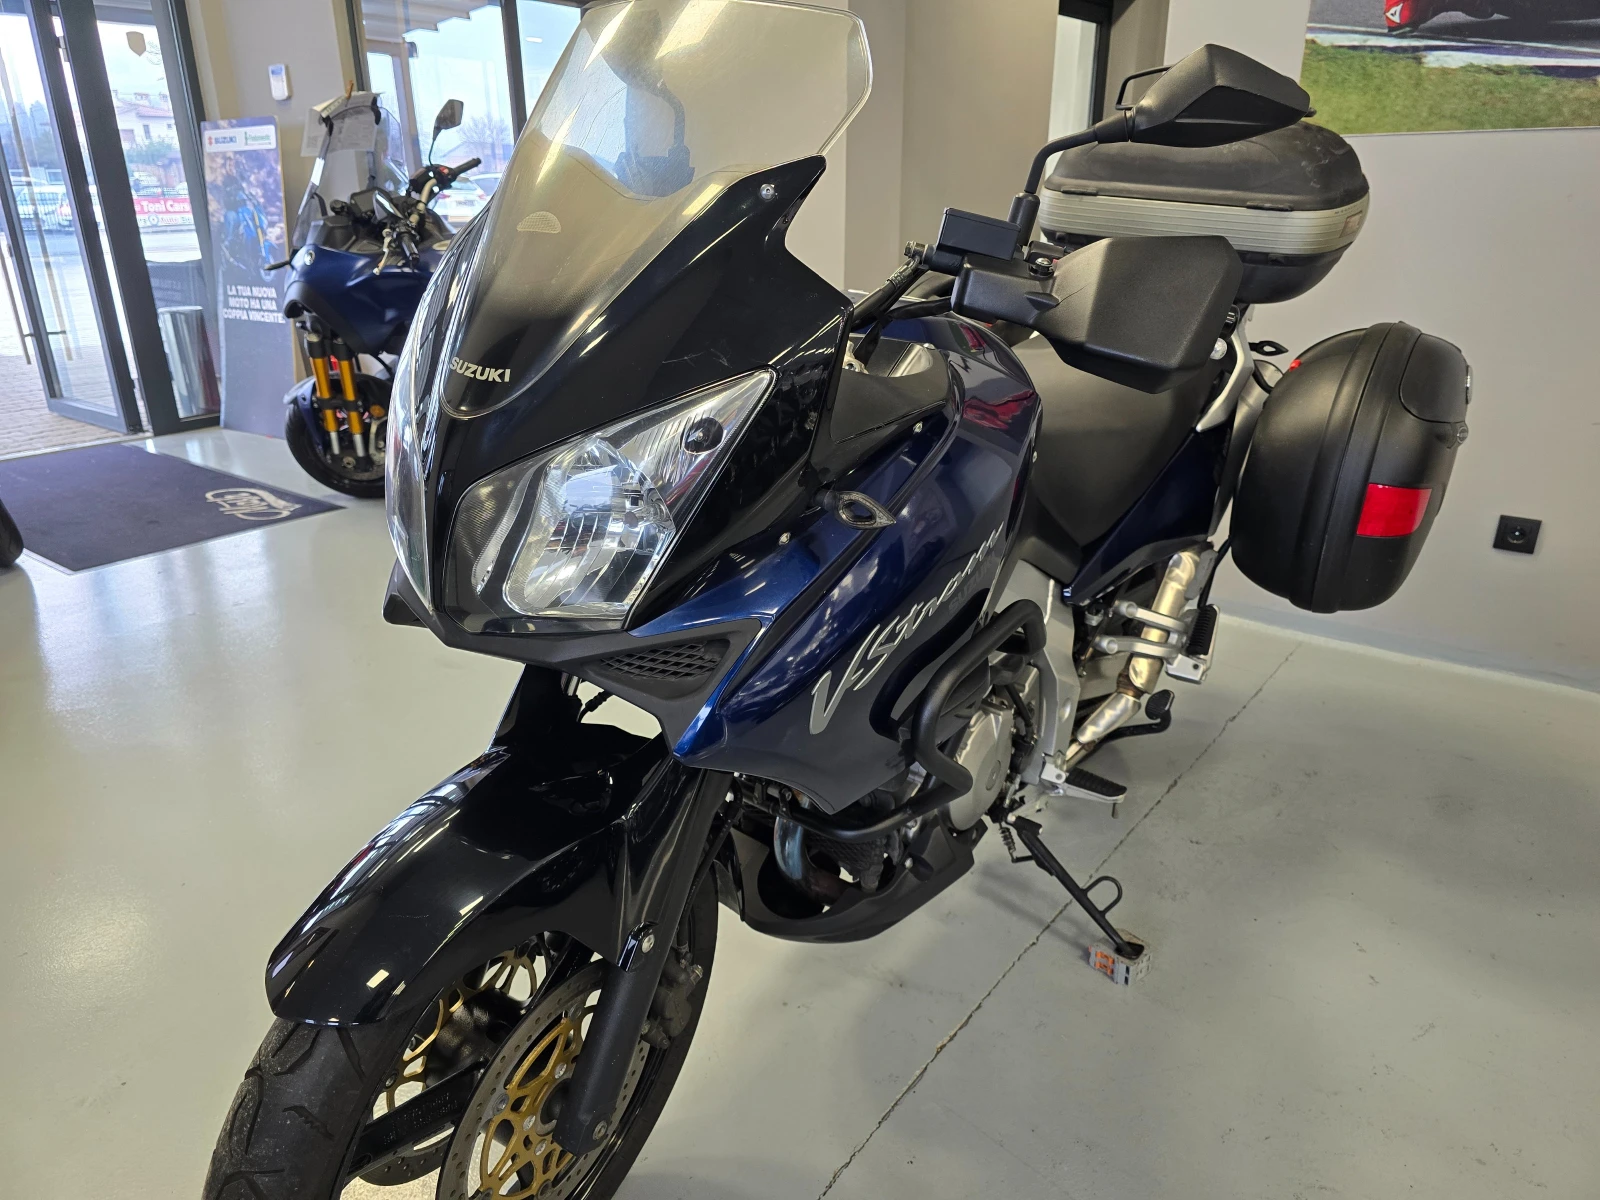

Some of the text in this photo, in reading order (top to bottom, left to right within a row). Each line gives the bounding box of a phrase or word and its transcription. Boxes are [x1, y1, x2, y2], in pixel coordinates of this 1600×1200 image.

[214, 135, 237, 145] SUZUKI
[141, 200, 166, 212] Toni
[166, 200, 190, 212] Cars
[226, 285, 277, 298] LA TUA NUOVA
[228, 297, 277, 310] MOTO HA UNA
[223, 308, 248, 320] COPPIA
[450, 356, 511, 382] SUZUKI
